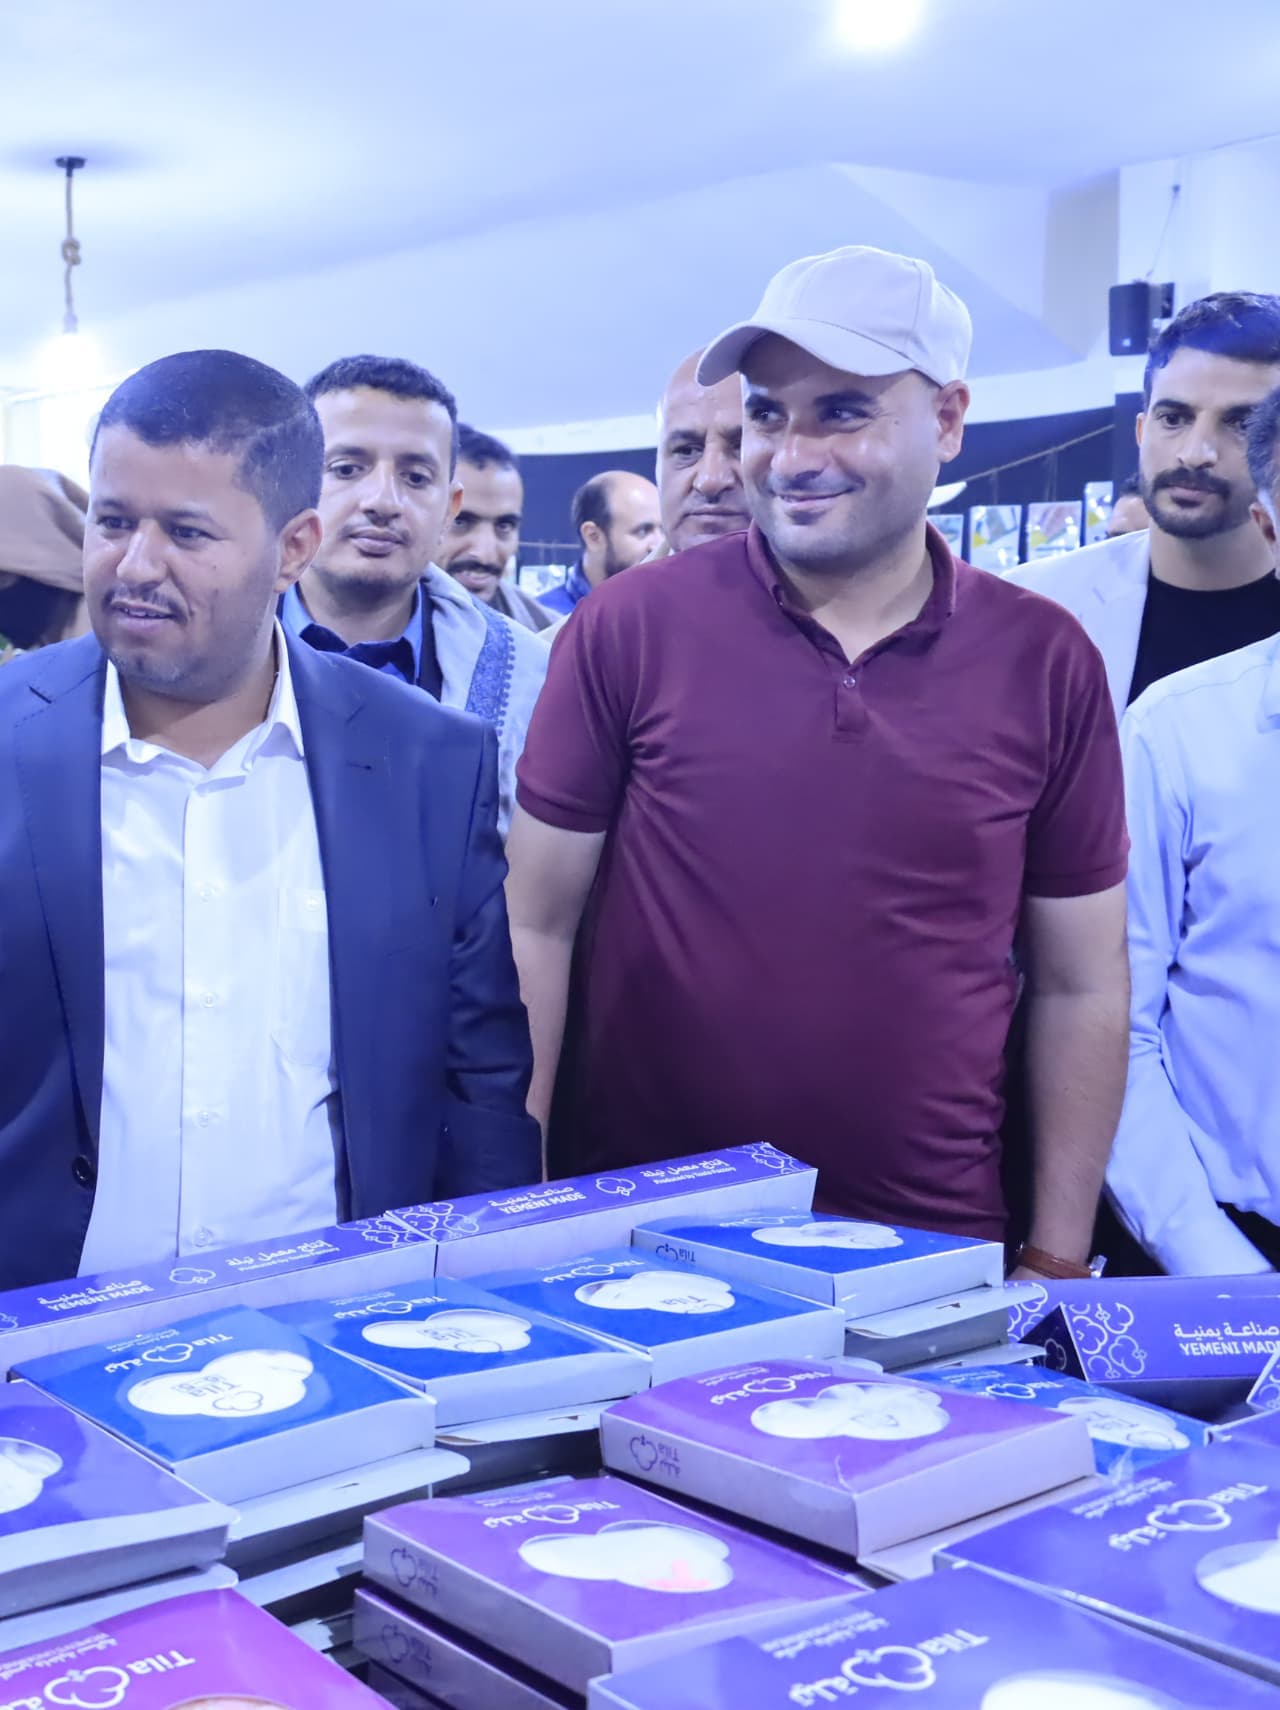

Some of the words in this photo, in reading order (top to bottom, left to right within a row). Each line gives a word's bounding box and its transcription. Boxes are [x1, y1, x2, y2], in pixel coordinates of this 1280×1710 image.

[499, 1199, 550, 1214] YEMENI
[549, 1192, 586, 1204] MADE
[679, 1248, 696, 1262] Tila
[48, 1294, 110, 1311] YEMENI
[109, 1285, 154, 1298] MADE
[1174, 1323, 1223, 1341] يمنية
[1223, 1321, 1280, 1337] صناعة
[192, 1333, 233, 1346] Tila
[1179, 1341, 1241, 1356] YEMENI
[789, 1371, 832, 1382] Tila
[658, 1442, 680, 1461] Tila
[1208, 1482, 1268, 1503] Tila
[575, 1500, 620, 1510] Tila
[916, 1628, 990, 1655] Tila
[126, 1650, 196, 1675] Tila
[788, 1676, 858, 1707] تيلة
